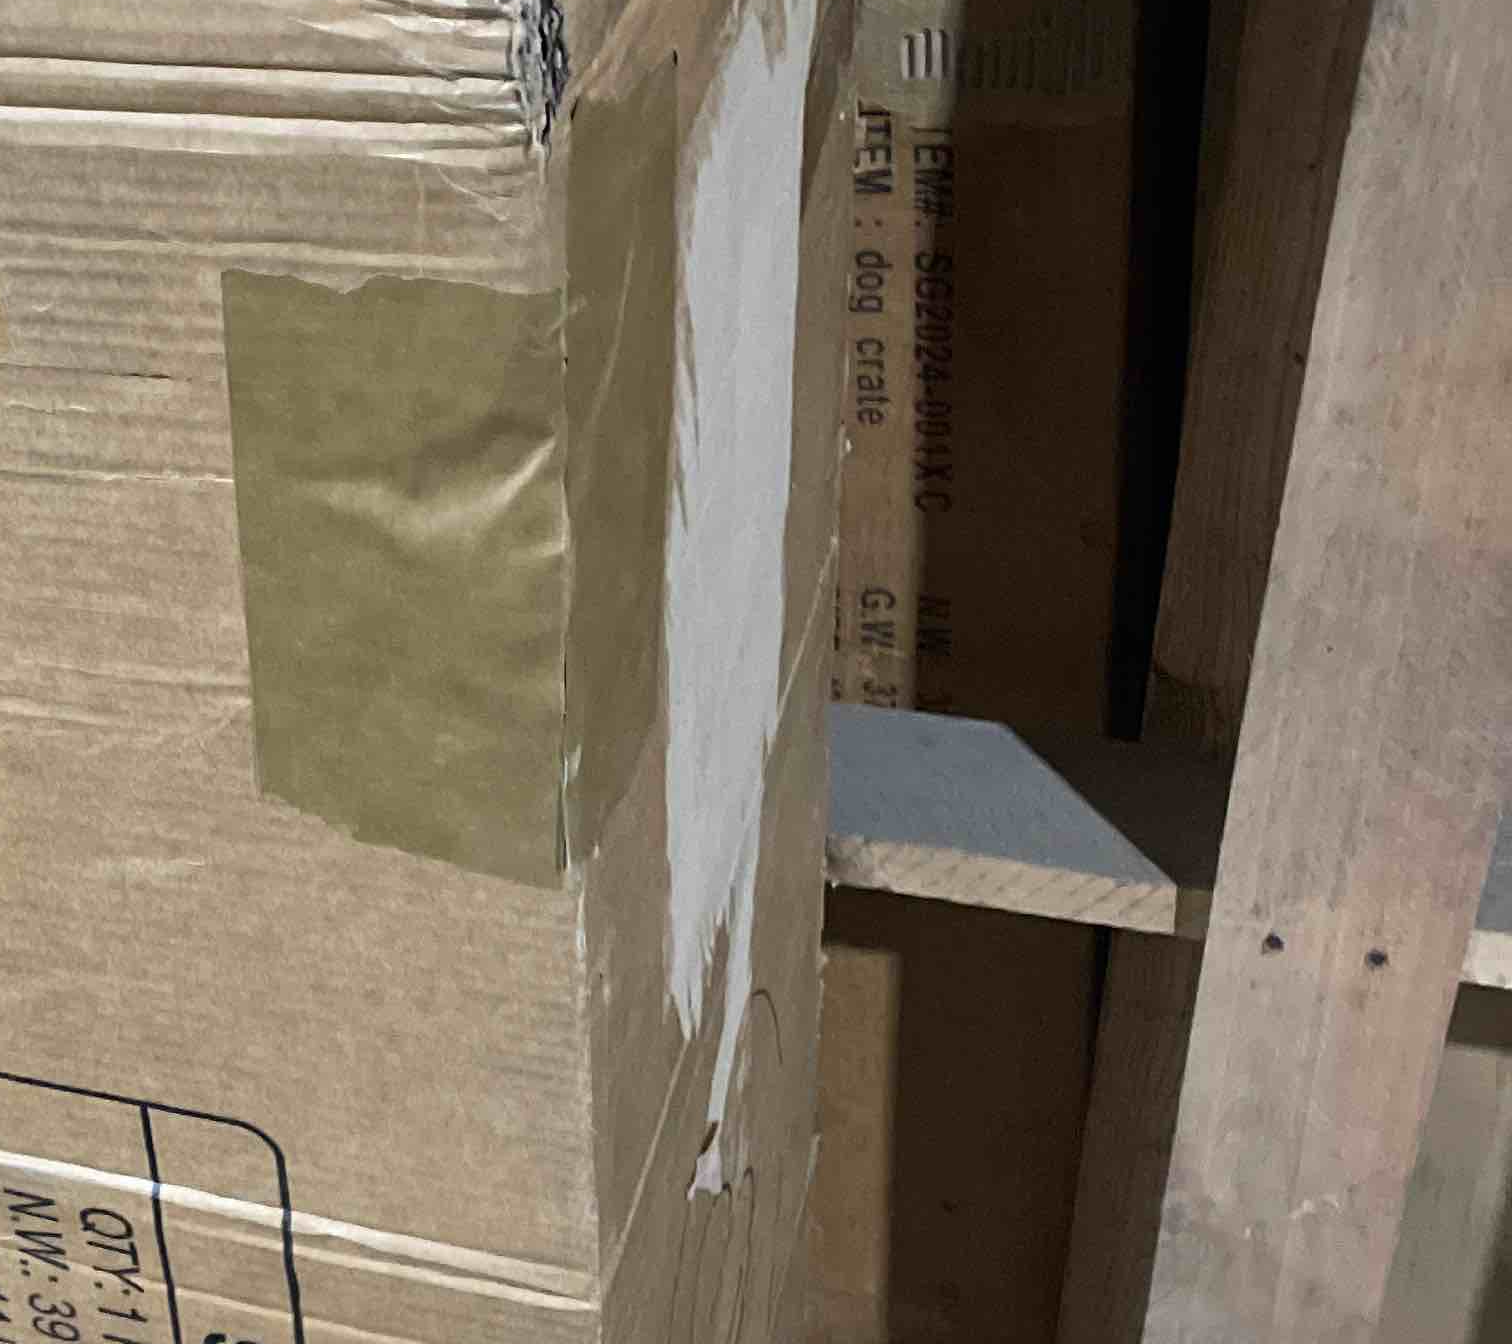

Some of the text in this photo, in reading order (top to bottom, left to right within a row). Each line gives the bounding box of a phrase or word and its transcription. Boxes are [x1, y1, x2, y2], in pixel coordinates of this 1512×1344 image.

[848, 248, 893, 313] dog
[855, 336, 890, 426] crate
[79, 1206, 145, 1297] QTY:
[28, 1291, 82, 1343] 39
[97, 1306, 150, 1324] 1
